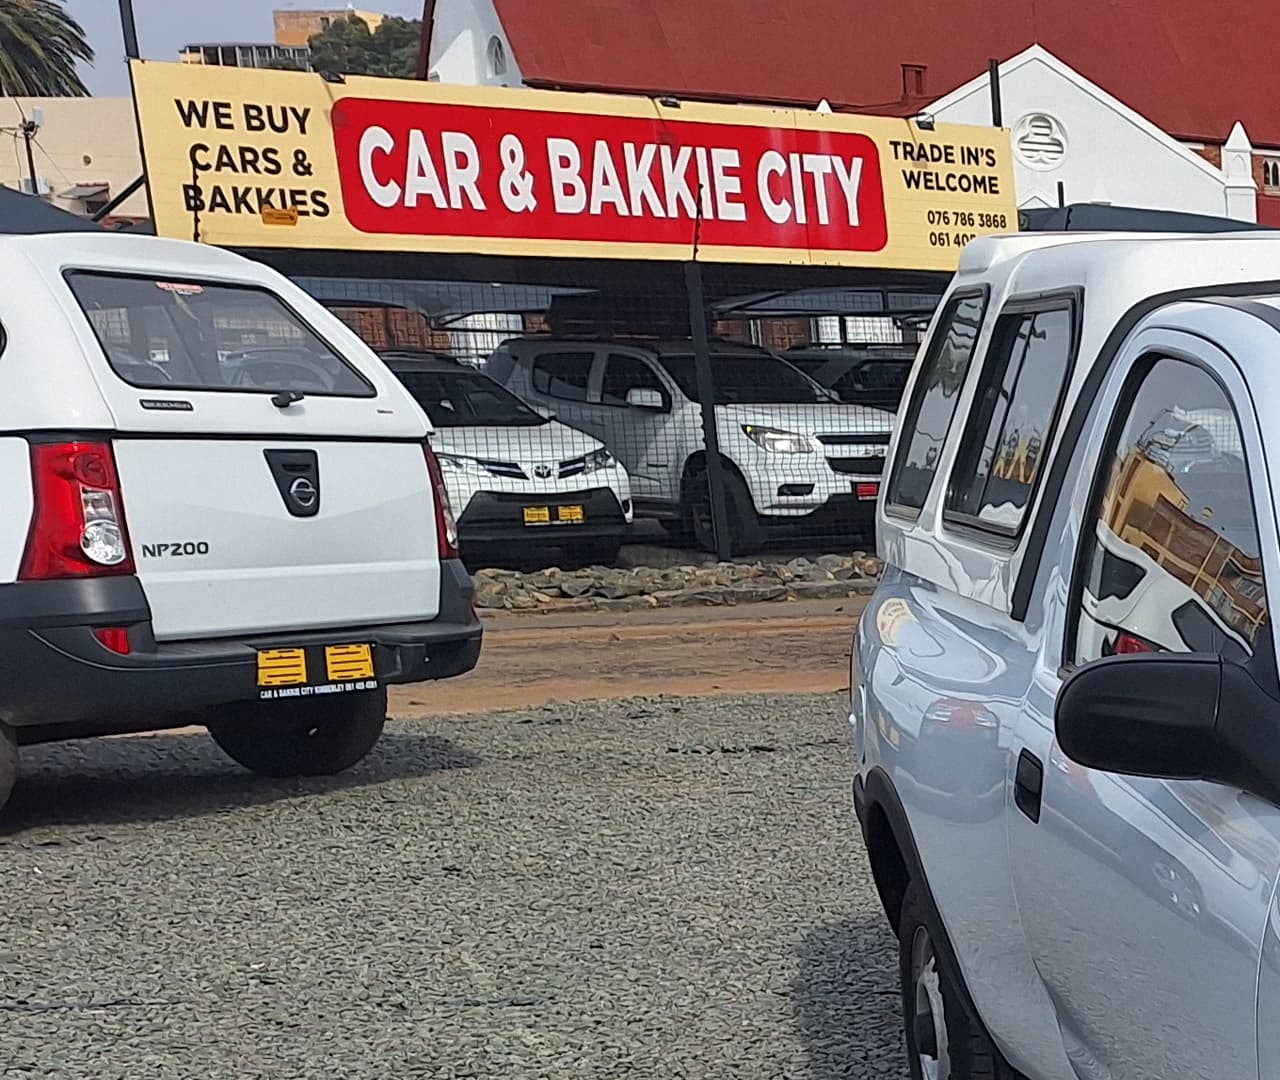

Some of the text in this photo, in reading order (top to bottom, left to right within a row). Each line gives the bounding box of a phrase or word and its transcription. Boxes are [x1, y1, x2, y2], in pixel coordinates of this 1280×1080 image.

[174, 99, 311, 135] WE BUY
[190, 143, 313, 176] CARS &
[889, 140, 996, 167] TRADE IN'S
[358, 125, 863, 226] CAR & BAKKIE CITY
[902, 169, 1000, 194] WELCOME
[183, 184, 330, 217] BAKKIES
[927, 210, 1007, 229] 076 786 3868
[929, 232, 950, 246] 061
[142, 542, 209, 558] NP200
